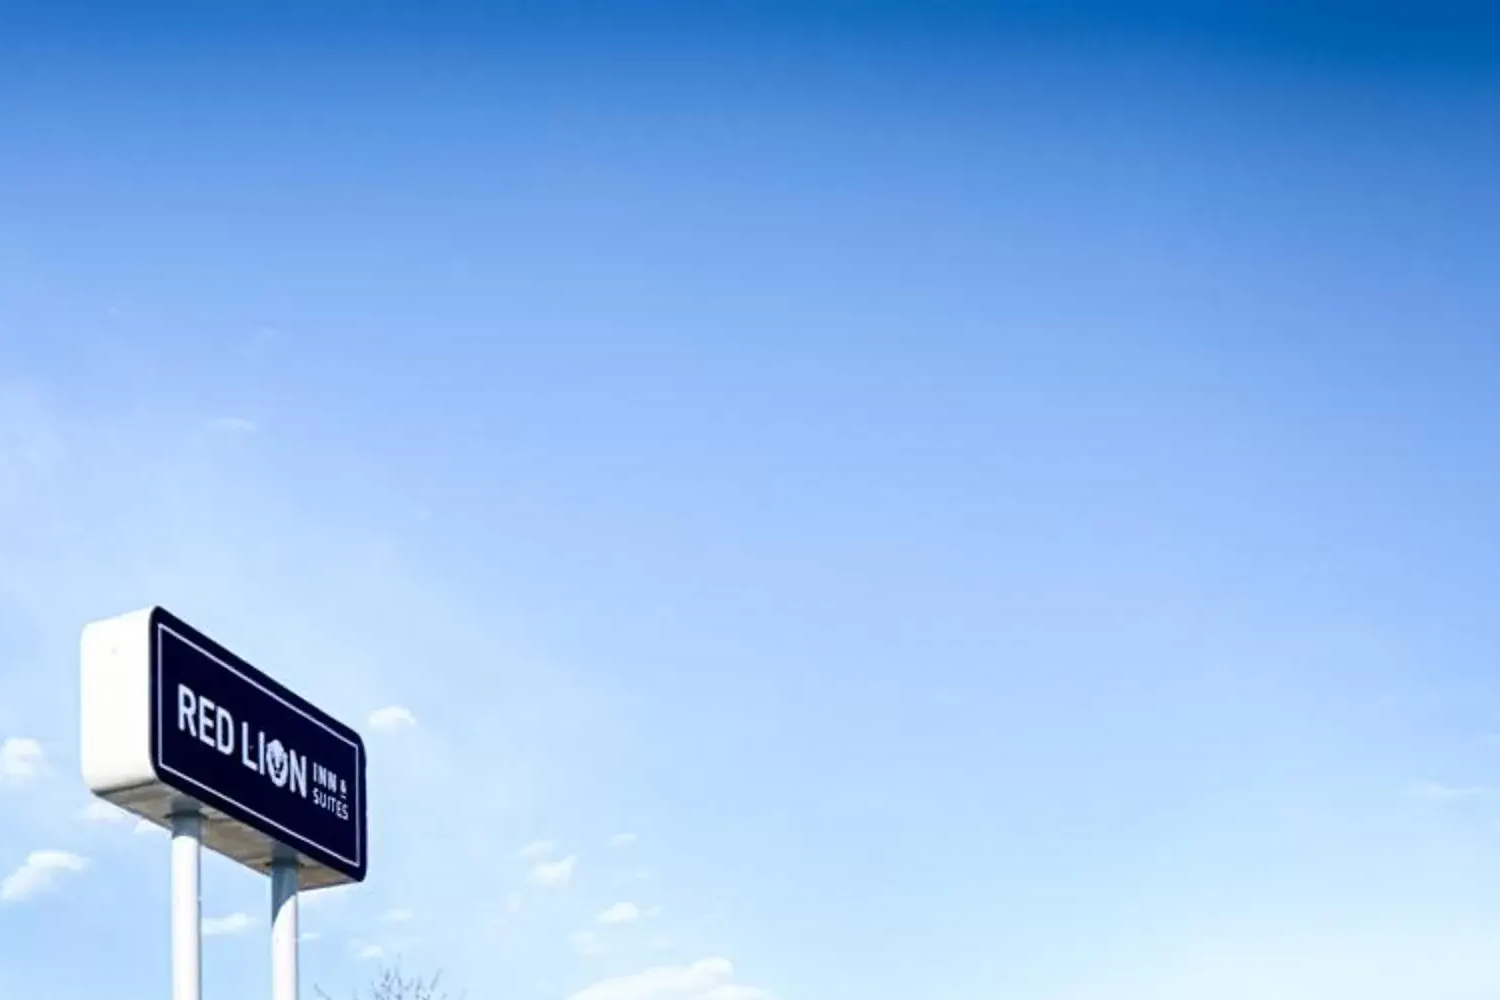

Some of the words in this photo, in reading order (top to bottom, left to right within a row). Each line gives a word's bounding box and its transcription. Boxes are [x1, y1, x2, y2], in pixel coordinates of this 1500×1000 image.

[178, 683, 234, 756] RED
[242, 722, 307, 799] LION
[313, 762, 337, 793] INN
[312, 787, 349, 820] SUITES
